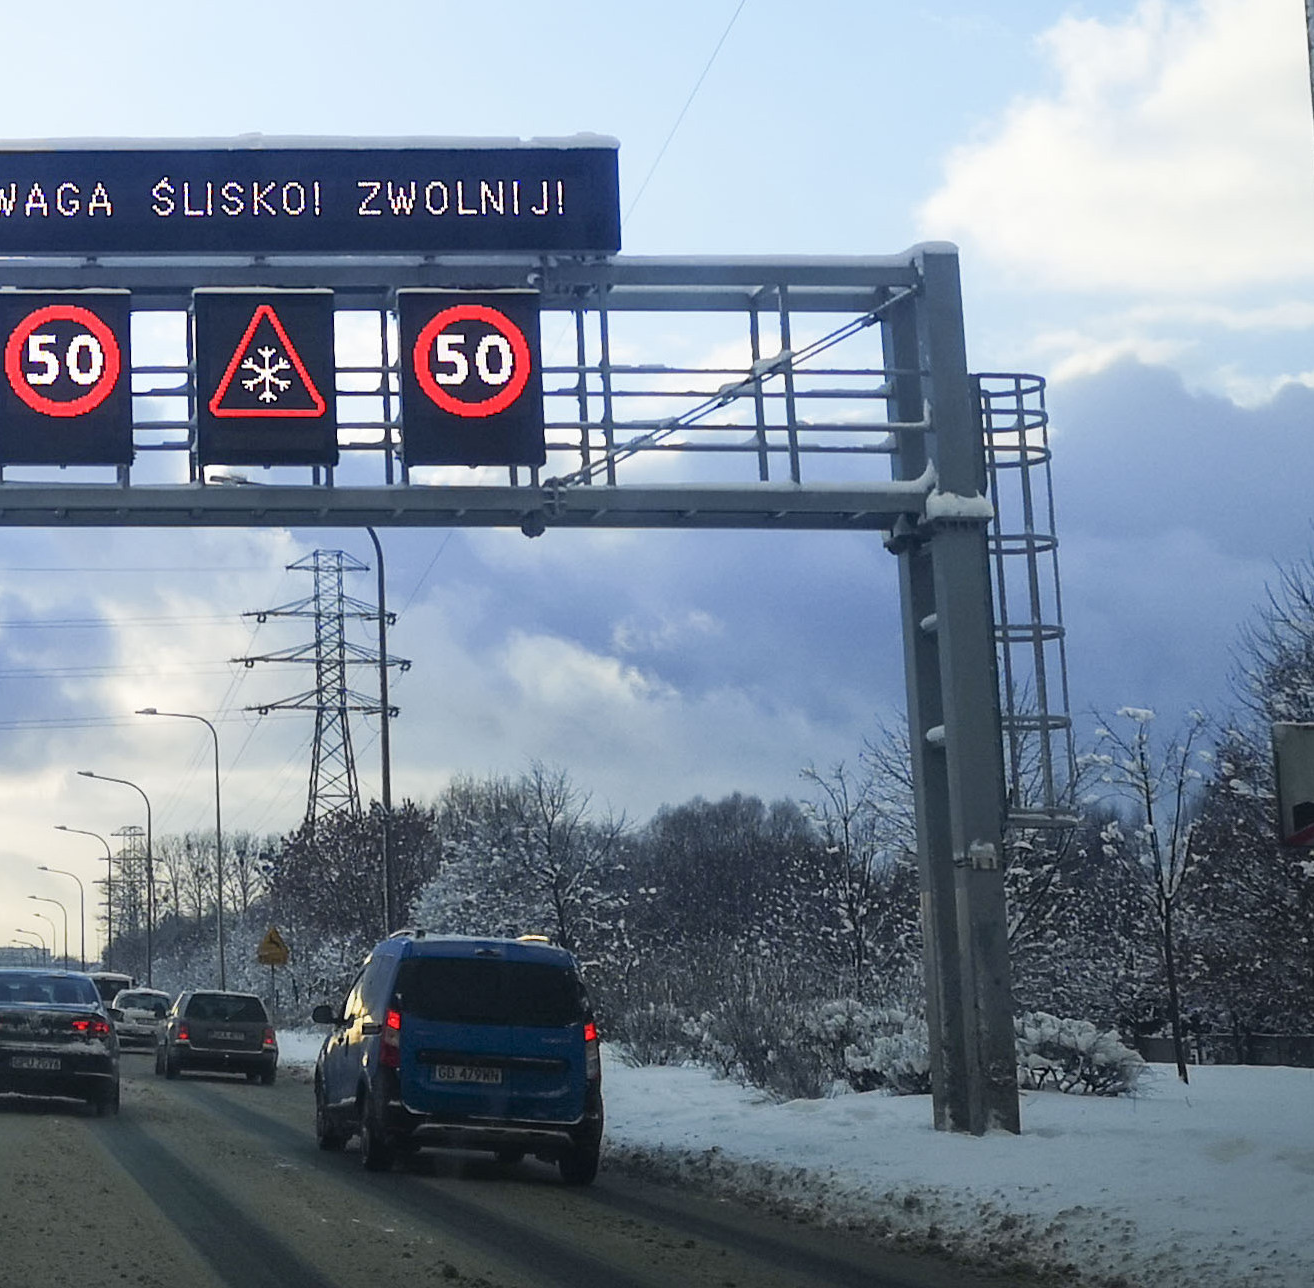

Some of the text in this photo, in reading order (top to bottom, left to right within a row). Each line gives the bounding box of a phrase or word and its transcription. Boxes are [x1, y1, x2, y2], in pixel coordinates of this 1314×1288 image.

[151, 176, 321, 216] ŚLISKO!
[357, 180, 565, 216] ZWOLNIJ!
[27, 334, 104, 385] 50
[435, 334, 513, 385] 50
